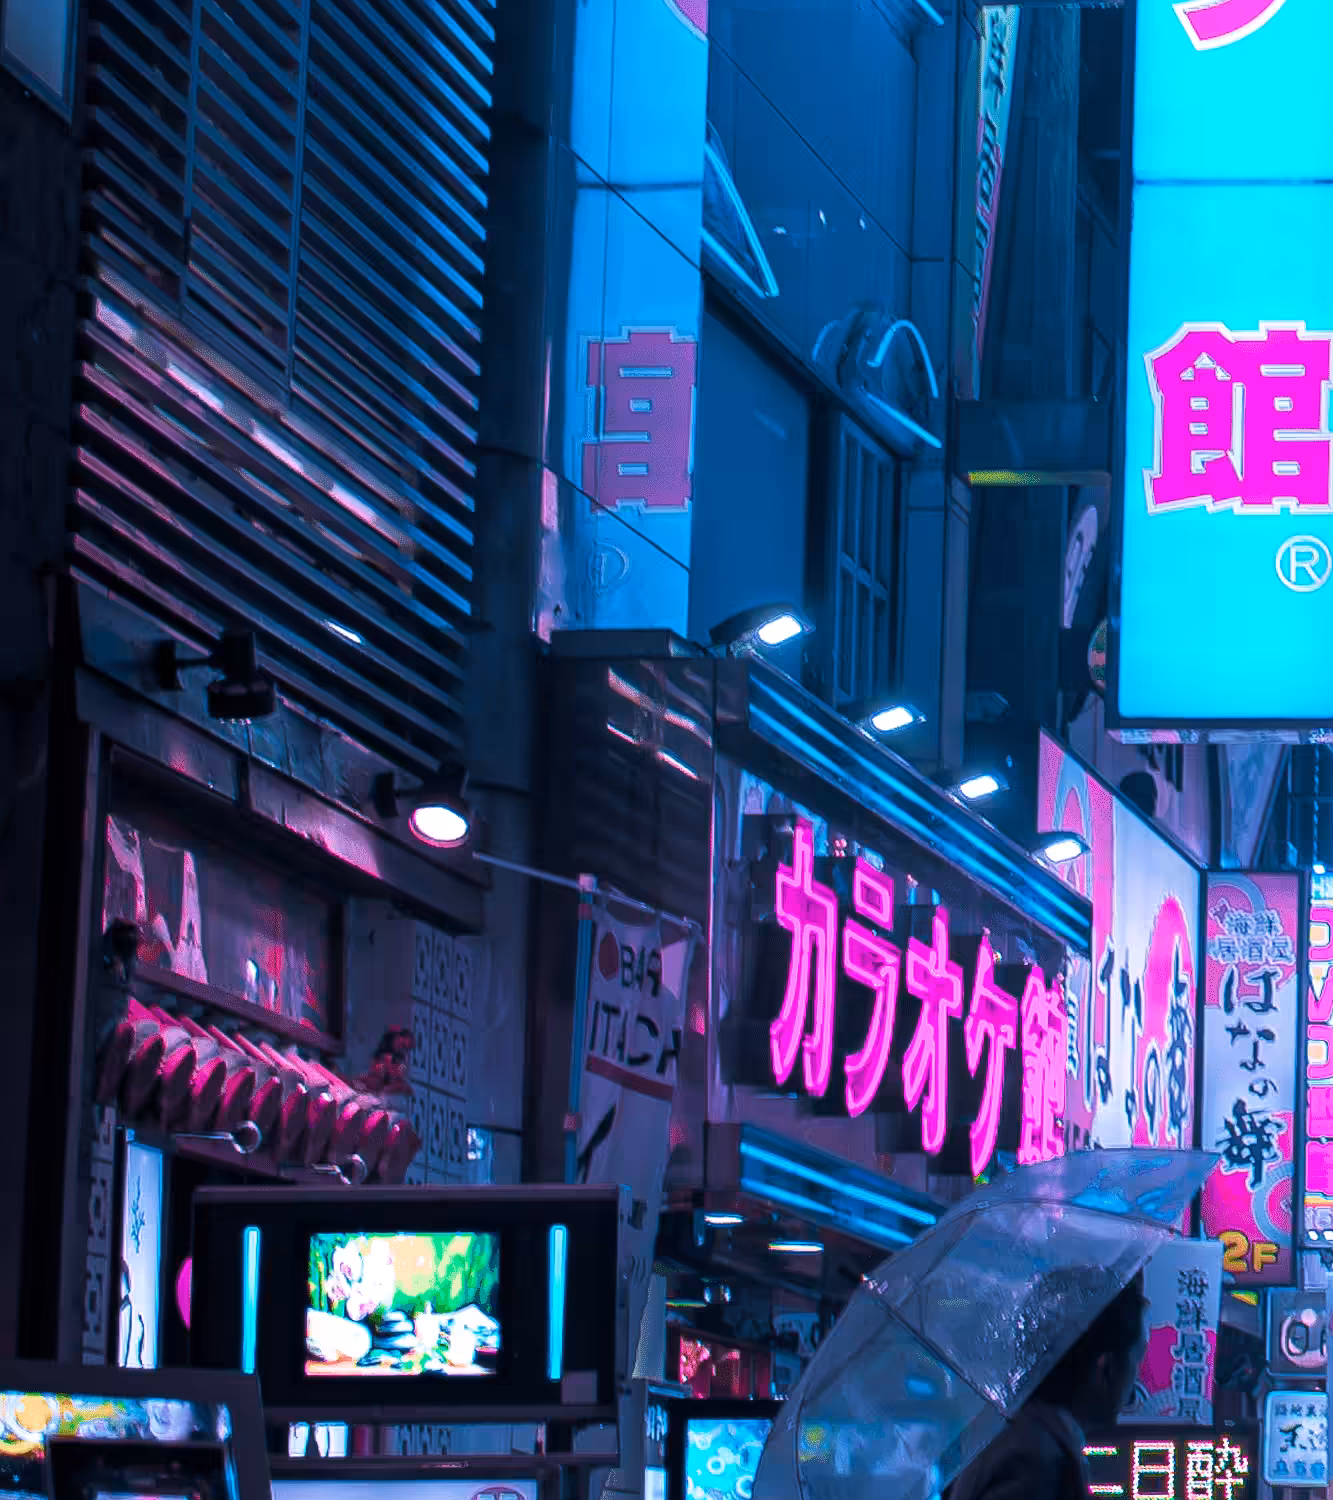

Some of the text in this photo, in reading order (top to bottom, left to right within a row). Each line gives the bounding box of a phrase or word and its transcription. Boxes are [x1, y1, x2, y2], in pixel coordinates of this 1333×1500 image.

[769, 817, 1066, 1185] カラオケ館
[1218, 1230, 1280, 1272] 2F
